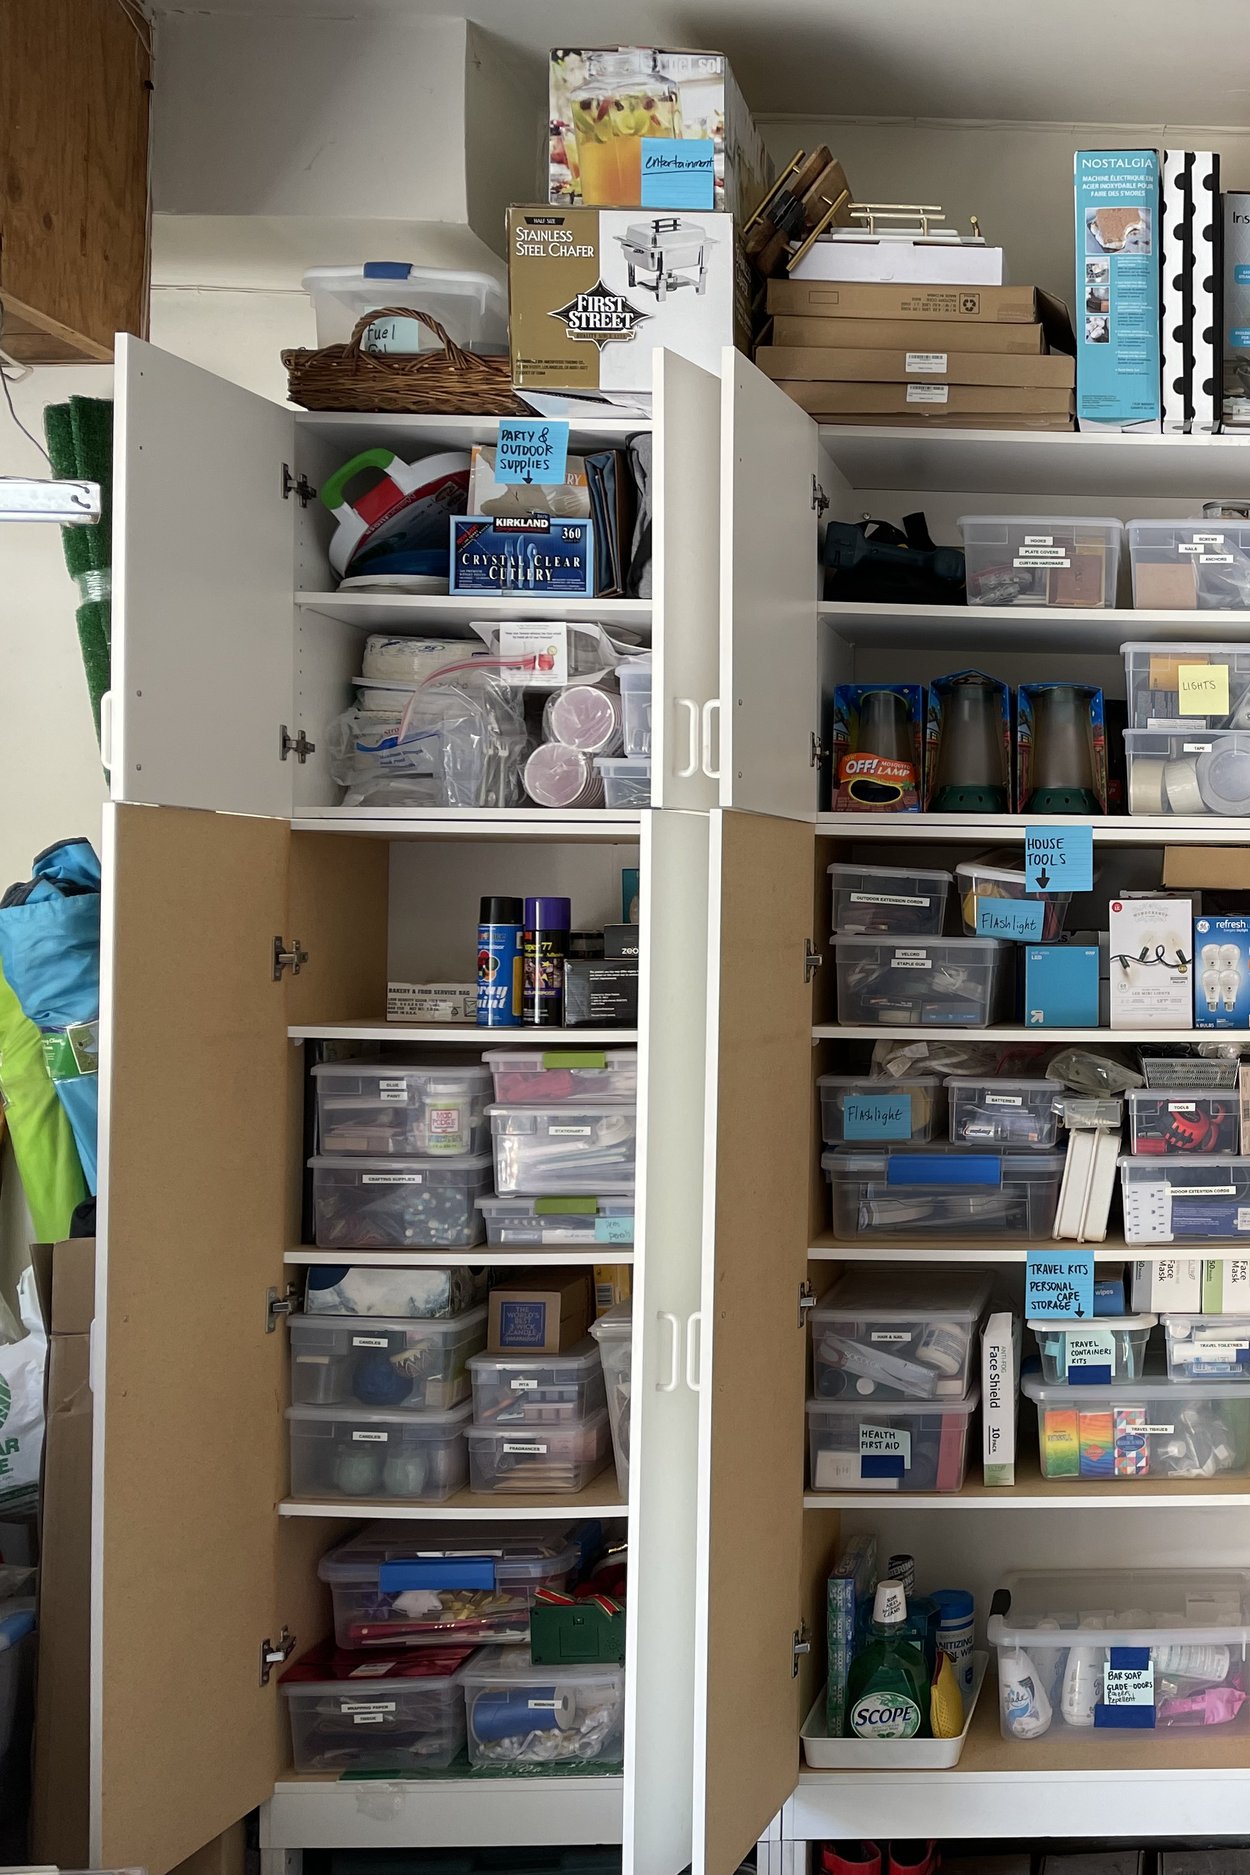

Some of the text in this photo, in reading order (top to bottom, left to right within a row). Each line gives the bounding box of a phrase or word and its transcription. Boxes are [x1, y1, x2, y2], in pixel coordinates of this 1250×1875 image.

[1082, 158, 1153, 168] NOSTALGIA
[516, 226, 573, 242] STAINLESS
[516, 241, 594, 257] STEEL CHAFER
[577, 295, 626, 312] FIRST
[569, 311, 634, 328] STREET
[501, 427, 550, 443] PARTY &
[501, 443, 553, 456] OUTDOOR
[495, 518, 549, 527] KIRKLAND
[562, 528, 581, 539] 360
[462, 553, 581, 568] CRYSTAL CLEAR
[488, 566, 553, 581] CUTLERY
[1182, 680, 1216, 692] LIGHTS
[845, 759, 879, 774] OFF!
[877, 767, 910, 777] LAMP
[1027, 838, 1064, 851] HOUSE
[1027, 852, 1066, 867] TOOLS
[1216, 919, 1246, 929] refresh
[541, 942, 552, 950] 77
[1029, 1263, 1088, 1276] TRAVEL KITS
[1231, 1260, 1239, 1284] Mask
[1240, 1261, 1248, 1281] Face
[1029, 1282, 1074, 1292] PERSONAL
[1095, 1289, 1114, 1297] wipes
[1057, 1292, 1080, 1302] CARE
[1031, 1300, 1071, 1311] STORAGE
[1070, 1348, 1112, 1357] CONTAINERS
[990, 1346, 1000, 1409] Face Shield
[861, 1430, 896, 1440] HEALTH
[992, 1427, 1000, 1439] 10
[861, 1440, 900, 1450] FIRST AID
[1108, 1671, 1142, 1681] BAR SOAP
[855, 1705, 914, 1727] SCOPE
